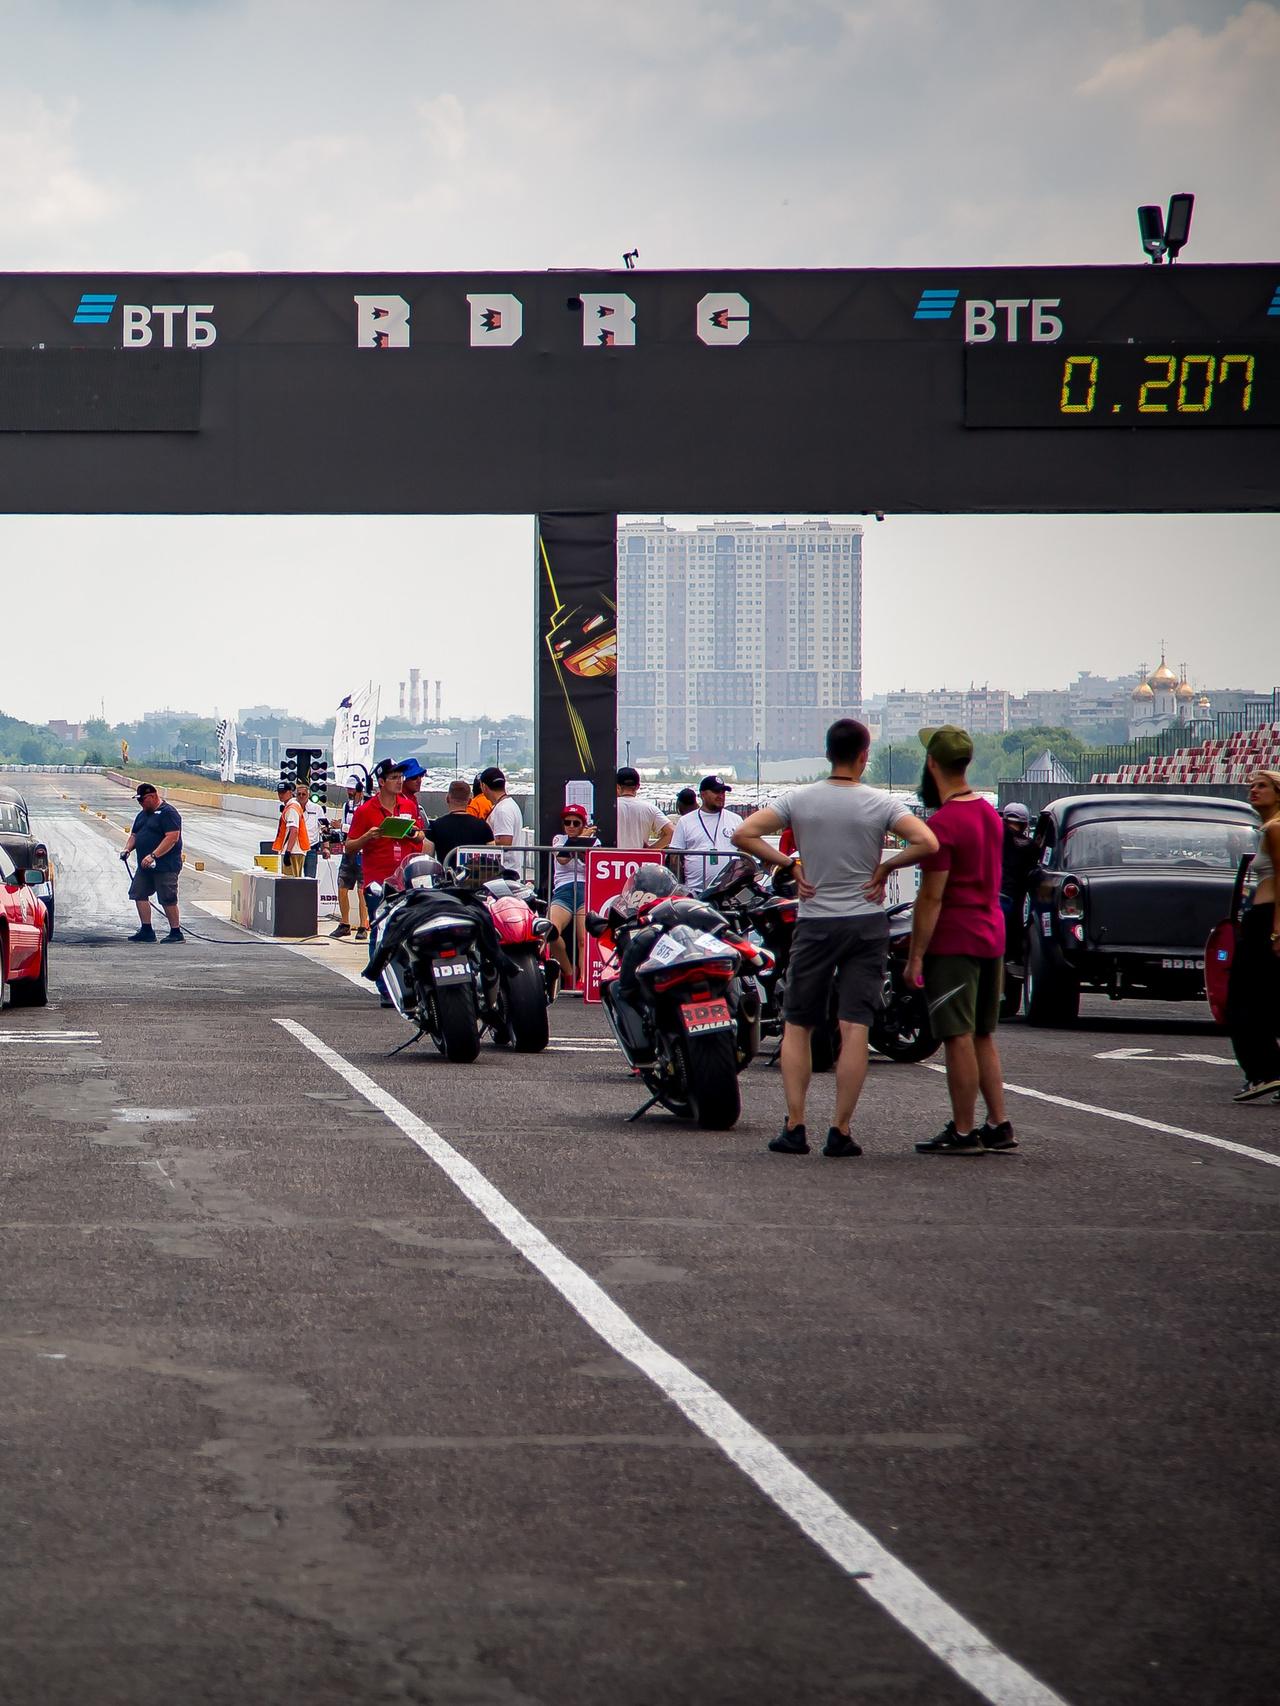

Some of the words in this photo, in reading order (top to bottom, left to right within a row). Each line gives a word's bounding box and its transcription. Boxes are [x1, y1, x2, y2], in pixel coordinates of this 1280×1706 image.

[122, 303, 217, 349] ВТБ
[965, 298, 1063, 344] ВТБ
[1061, 354, 1256, 414] 0.207
[596, 860, 652, 880] STO
[1162, 959, 1205, 969] RDRC
